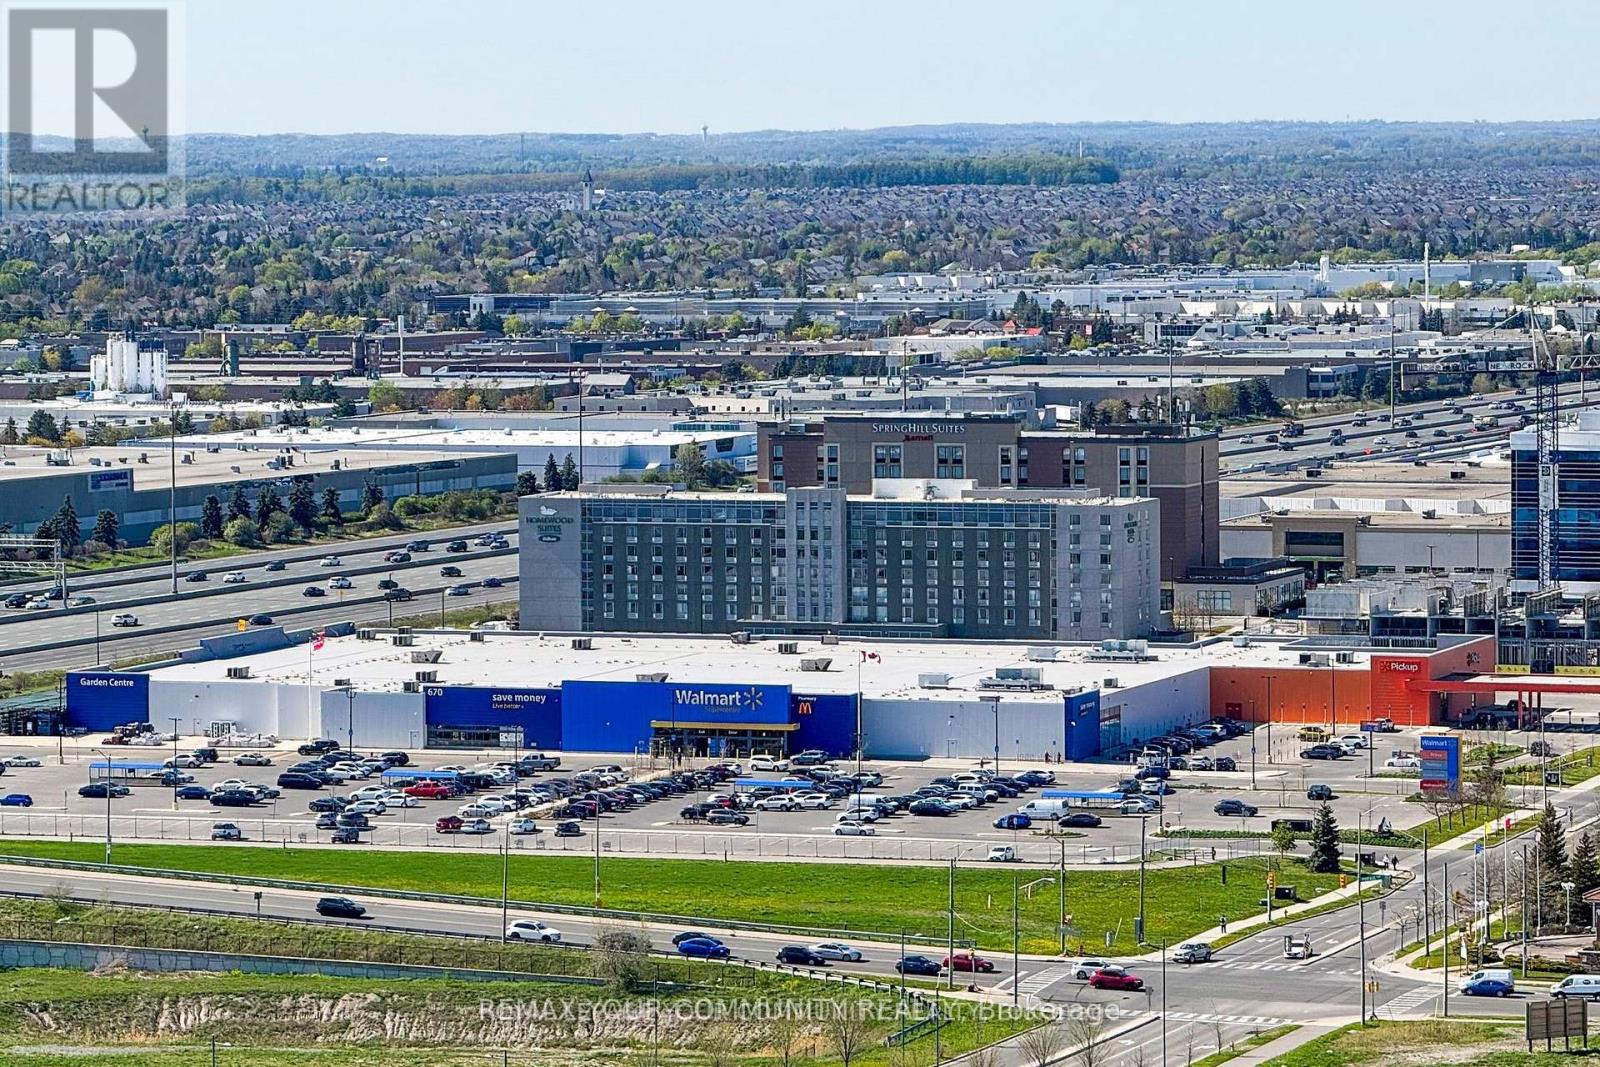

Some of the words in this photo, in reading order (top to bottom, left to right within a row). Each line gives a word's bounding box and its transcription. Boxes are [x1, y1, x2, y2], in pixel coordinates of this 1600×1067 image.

[1391, 663, 1418, 672] Pickup
[80, 677, 108, 686] Garden
[109, 678, 134, 687] Centre
[427, 688, 443, 696] 670
[492, 694, 513, 702] save
[514, 694, 546, 704] money
[675, 689, 742, 706] Walmart
